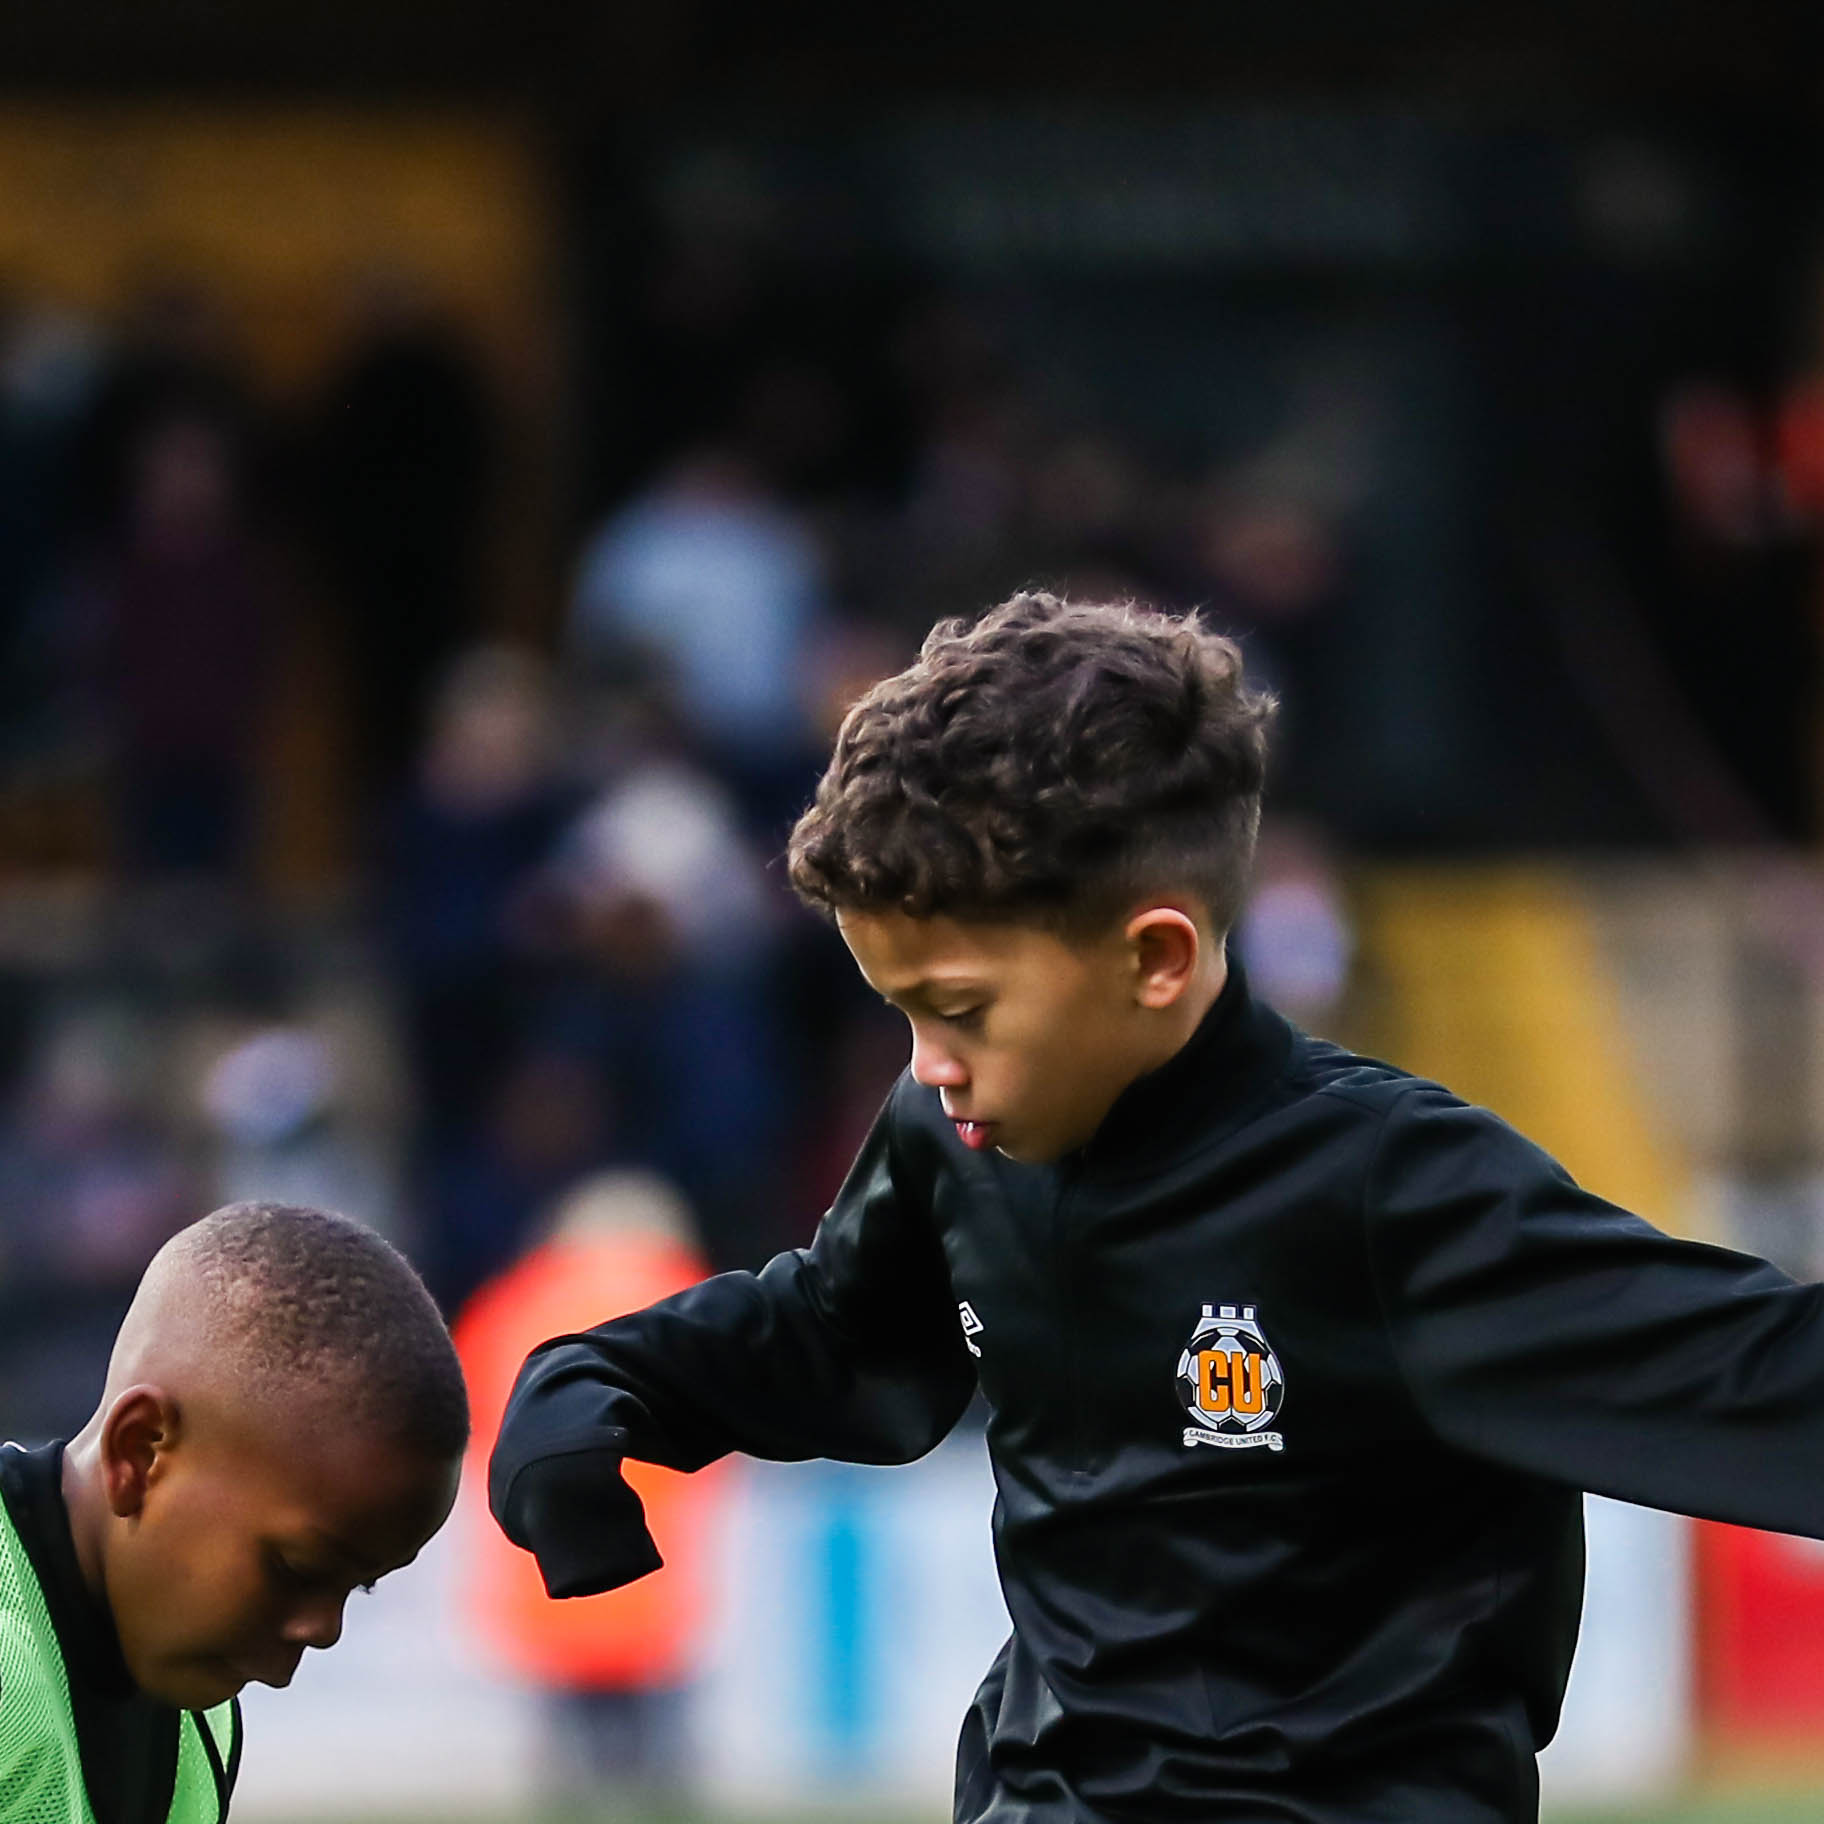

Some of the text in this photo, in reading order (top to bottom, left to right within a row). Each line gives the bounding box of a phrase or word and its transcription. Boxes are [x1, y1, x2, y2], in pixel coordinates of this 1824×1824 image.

[1197, 1349, 1266, 1415] CU
[1189, 1429, 1233, 1446] CAMBRIDGE
[1235, 1434, 1263, 1446] UNITED
